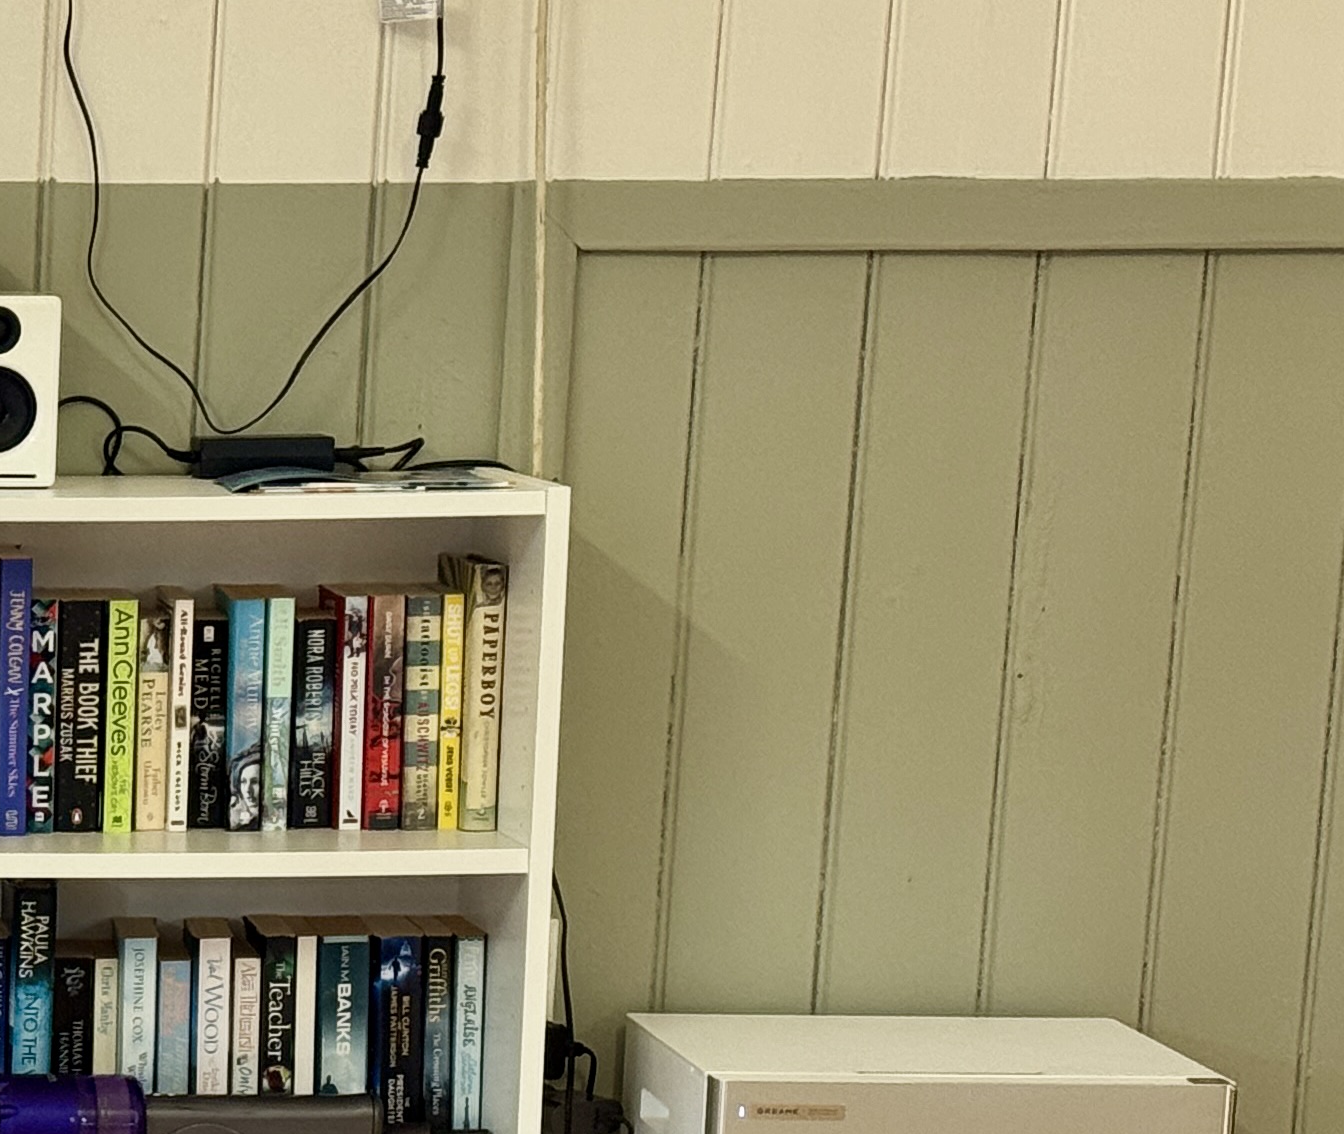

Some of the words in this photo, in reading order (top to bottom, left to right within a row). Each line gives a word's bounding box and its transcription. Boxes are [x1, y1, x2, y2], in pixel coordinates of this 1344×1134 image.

[113, 608, 134, 655] Ann
[79, 639, 100, 674] THE
[479, 611, 500, 720] PAPERBOY
[60, 668, 74, 720] MARKUS
[77, 683, 99, 730] BOOK
[110, 660, 134, 756] Cleeves
[59, 722, 73, 762] ZUSAK
[74, 735, 98, 784] THIEF
[18, 900, 37, 979] HAWKINS
[34, 916, 50, 965] PAULA
[274, 962, 286, 978] The
[267, 975, 292, 1062] Teacher
[335, 983, 353, 1056] BANKS
